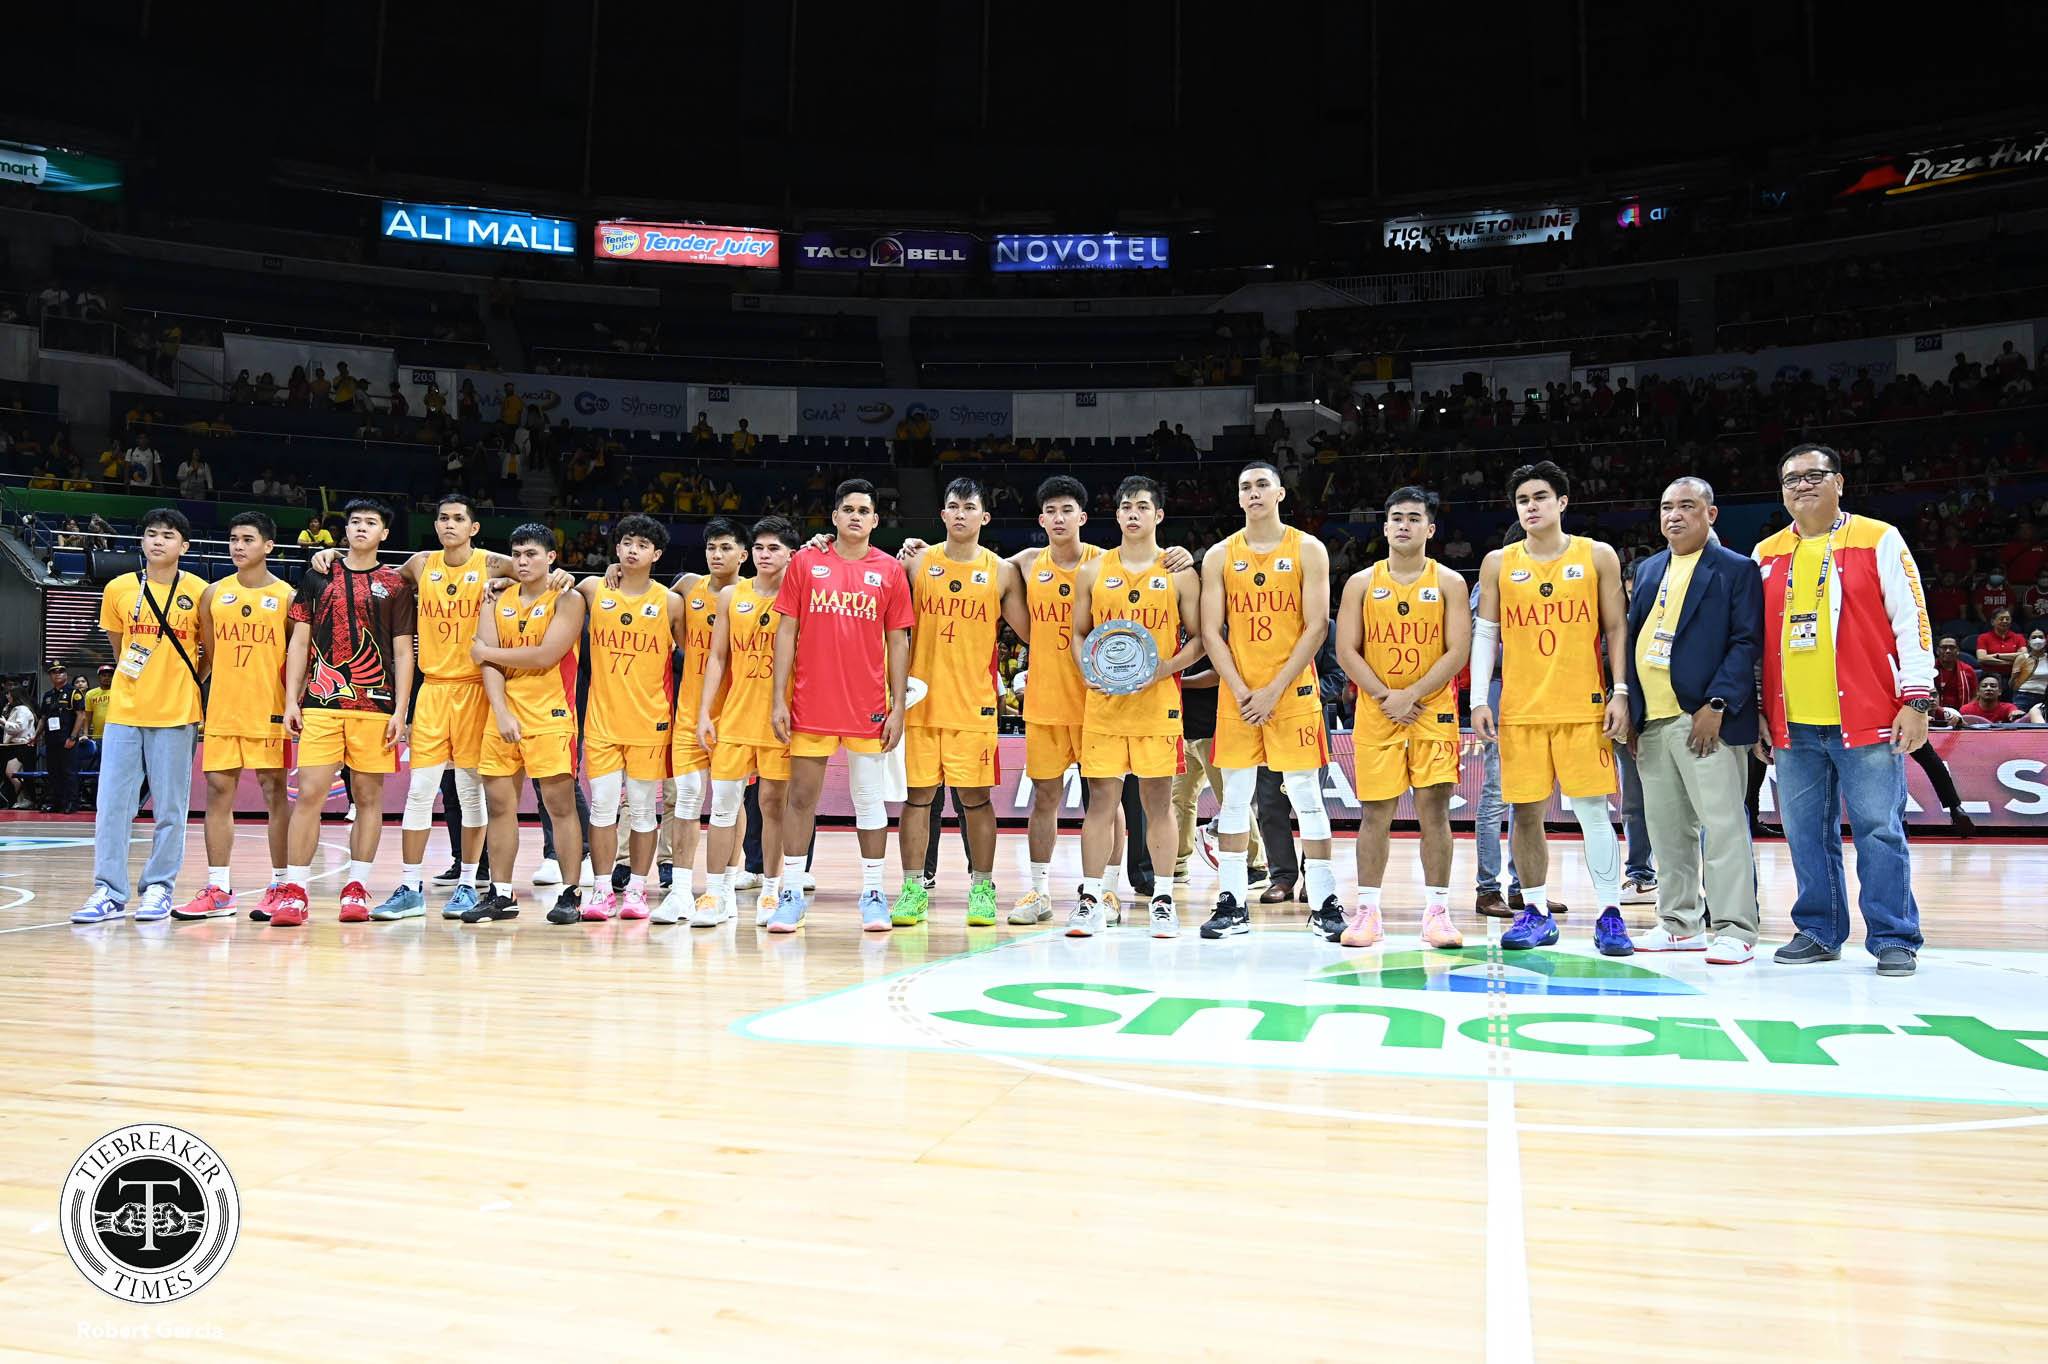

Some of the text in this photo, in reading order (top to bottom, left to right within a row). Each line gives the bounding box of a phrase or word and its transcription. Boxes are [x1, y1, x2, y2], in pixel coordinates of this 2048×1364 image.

[1904, 158, 1986, 186] Pizza
[386, 210, 575, 252] ALI MALL
[1389, 213, 1572, 242] TICKETNETONLINE
[605, 234, 638, 245] Tender
[610, 241, 635, 252] Juicy
[645, 232, 774, 257] Tender Juicy
[996, 237, 1167, 263] NOVOTEL
[802, 246, 967, 261] TACO BELL
[1916, 337, 1942, 351] 207
[413, 371, 434, 384] 203
[708, 388, 729, 401] 204
[621, 395, 682, 419] Synergy
[802, 407, 841, 421] GMA
[950, 405, 1009, 425] Synergy
[809, 605, 878, 621] UNIVERSITY
[1031, 601, 1071, 623] MAP
[438, 621, 462, 644] 91
[940, 620, 957, 643] 4
[1056, 626, 1071, 650] 5
[1248, 615, 1272, 642] 18
[1538, 628, 1556, 657] 0
[233, 645, 253, 668] 17
[610, 652, 636, 676] 77
[746, 655, 773, 679] 23
[1387, 647, 1421, 675] 29
[558, 736, 568, 753] 7
[1297, 725, 1316, 747] 18
[979, 748, 990, 765] 4
[1432, 741, 1454, 761] 29
[1599, 747, 1610, 768] 0
